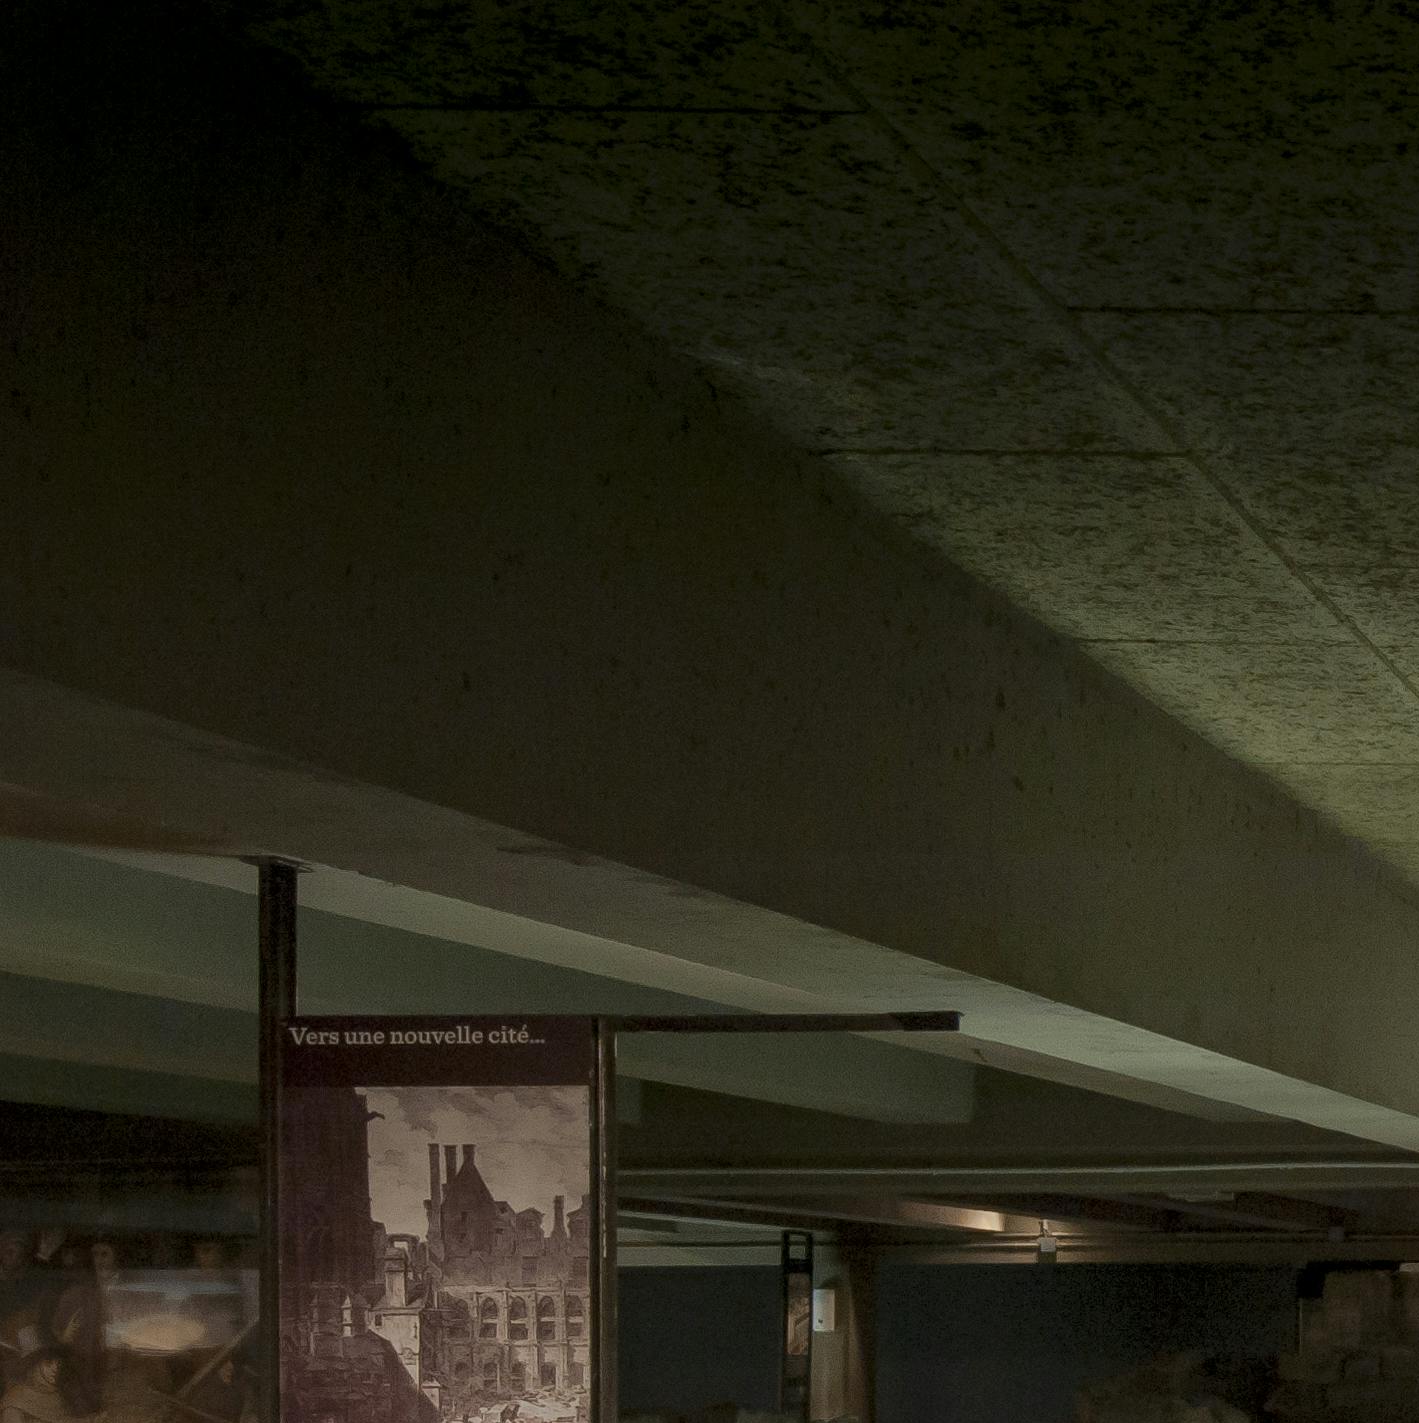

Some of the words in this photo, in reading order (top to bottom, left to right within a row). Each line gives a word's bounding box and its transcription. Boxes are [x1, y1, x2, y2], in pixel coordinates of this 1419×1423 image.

[289, 1027, 339, 1045] Vers
[345, 1030, 384, 1045] une
[390, 1026, 483, 1044] nouvelle
